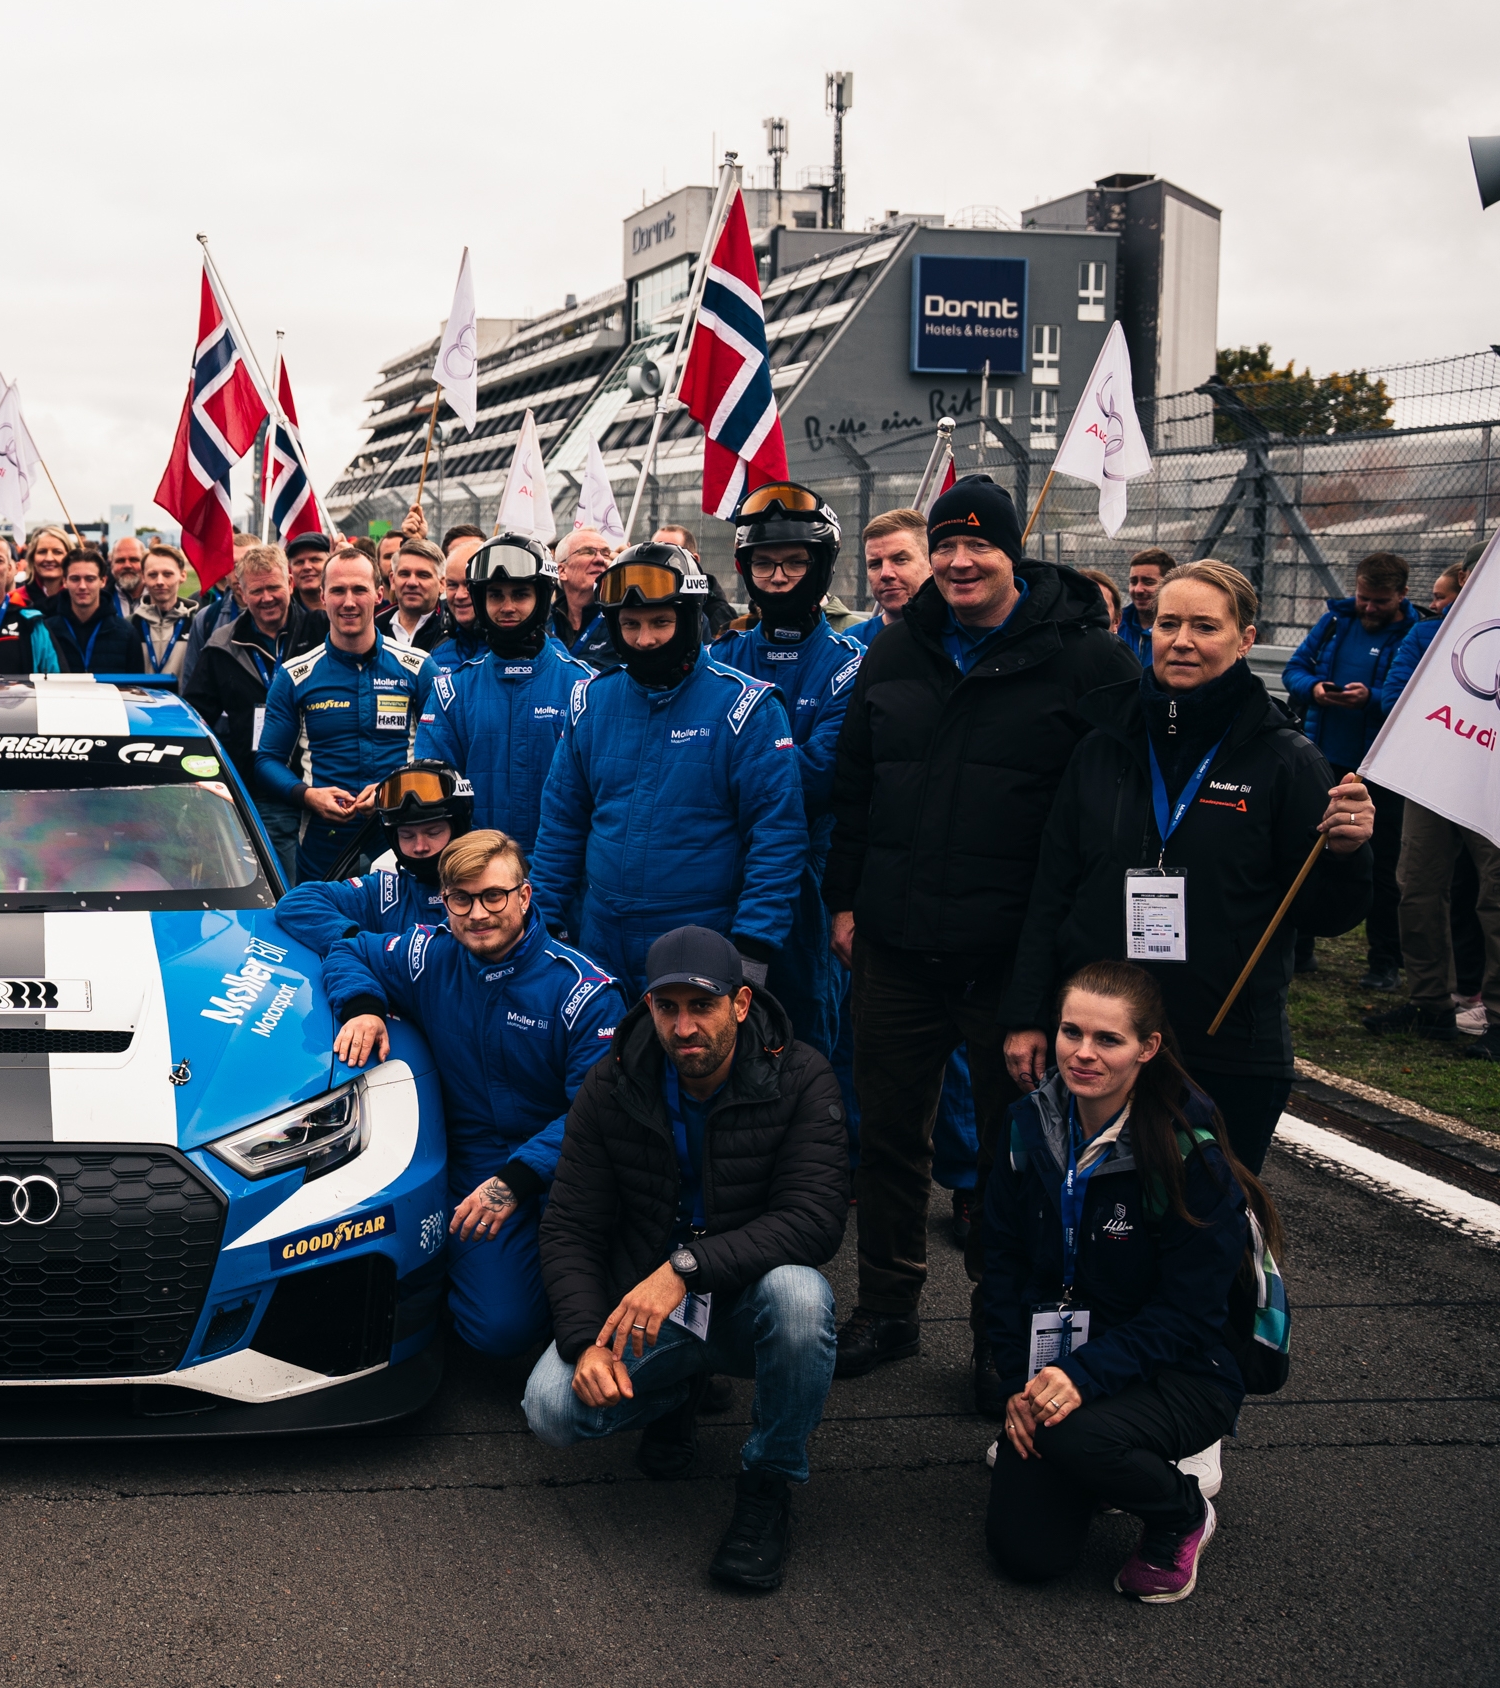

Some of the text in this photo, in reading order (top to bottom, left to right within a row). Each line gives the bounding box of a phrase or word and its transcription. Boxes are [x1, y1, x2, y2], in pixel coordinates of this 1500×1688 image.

[631, 210, 676, 255] Dorint
[924, 294, 1019, 320] Dorint
[925, 322, 1019, 339] Hotels & Resorts
[881, 411, 922, 431] ein
[929, 387, 982, 422] Bit
[402, 655, 420, 668] OMP
[766, 651, 799, 660] sparco
[292, 665, 309, 678] OMP
[504, 665, 533, 675] sparco
[732, 688, 759, 722] sparco
[699, 727, 710, 737] Bil
[1424, 704, 1497, 752] Audi
[5, 751, 90, 761] SIMULATOR
[1240, 784, 1252, 794] Bil
[384, 874, 394, 903] sparco
[428, 895, 443, 905] spa
[243, 936, 289, 964] Bil
[412, 933, 426, 970] sparco
[485, 966, 515, 983] sparco
[250, 983, 299, 1038] Motorsport
[564, 982, 594, 1018] sparco
[537, 1018, 549, 1030] Bil
[281, 1214, 386, 1260] GOODYEAR
